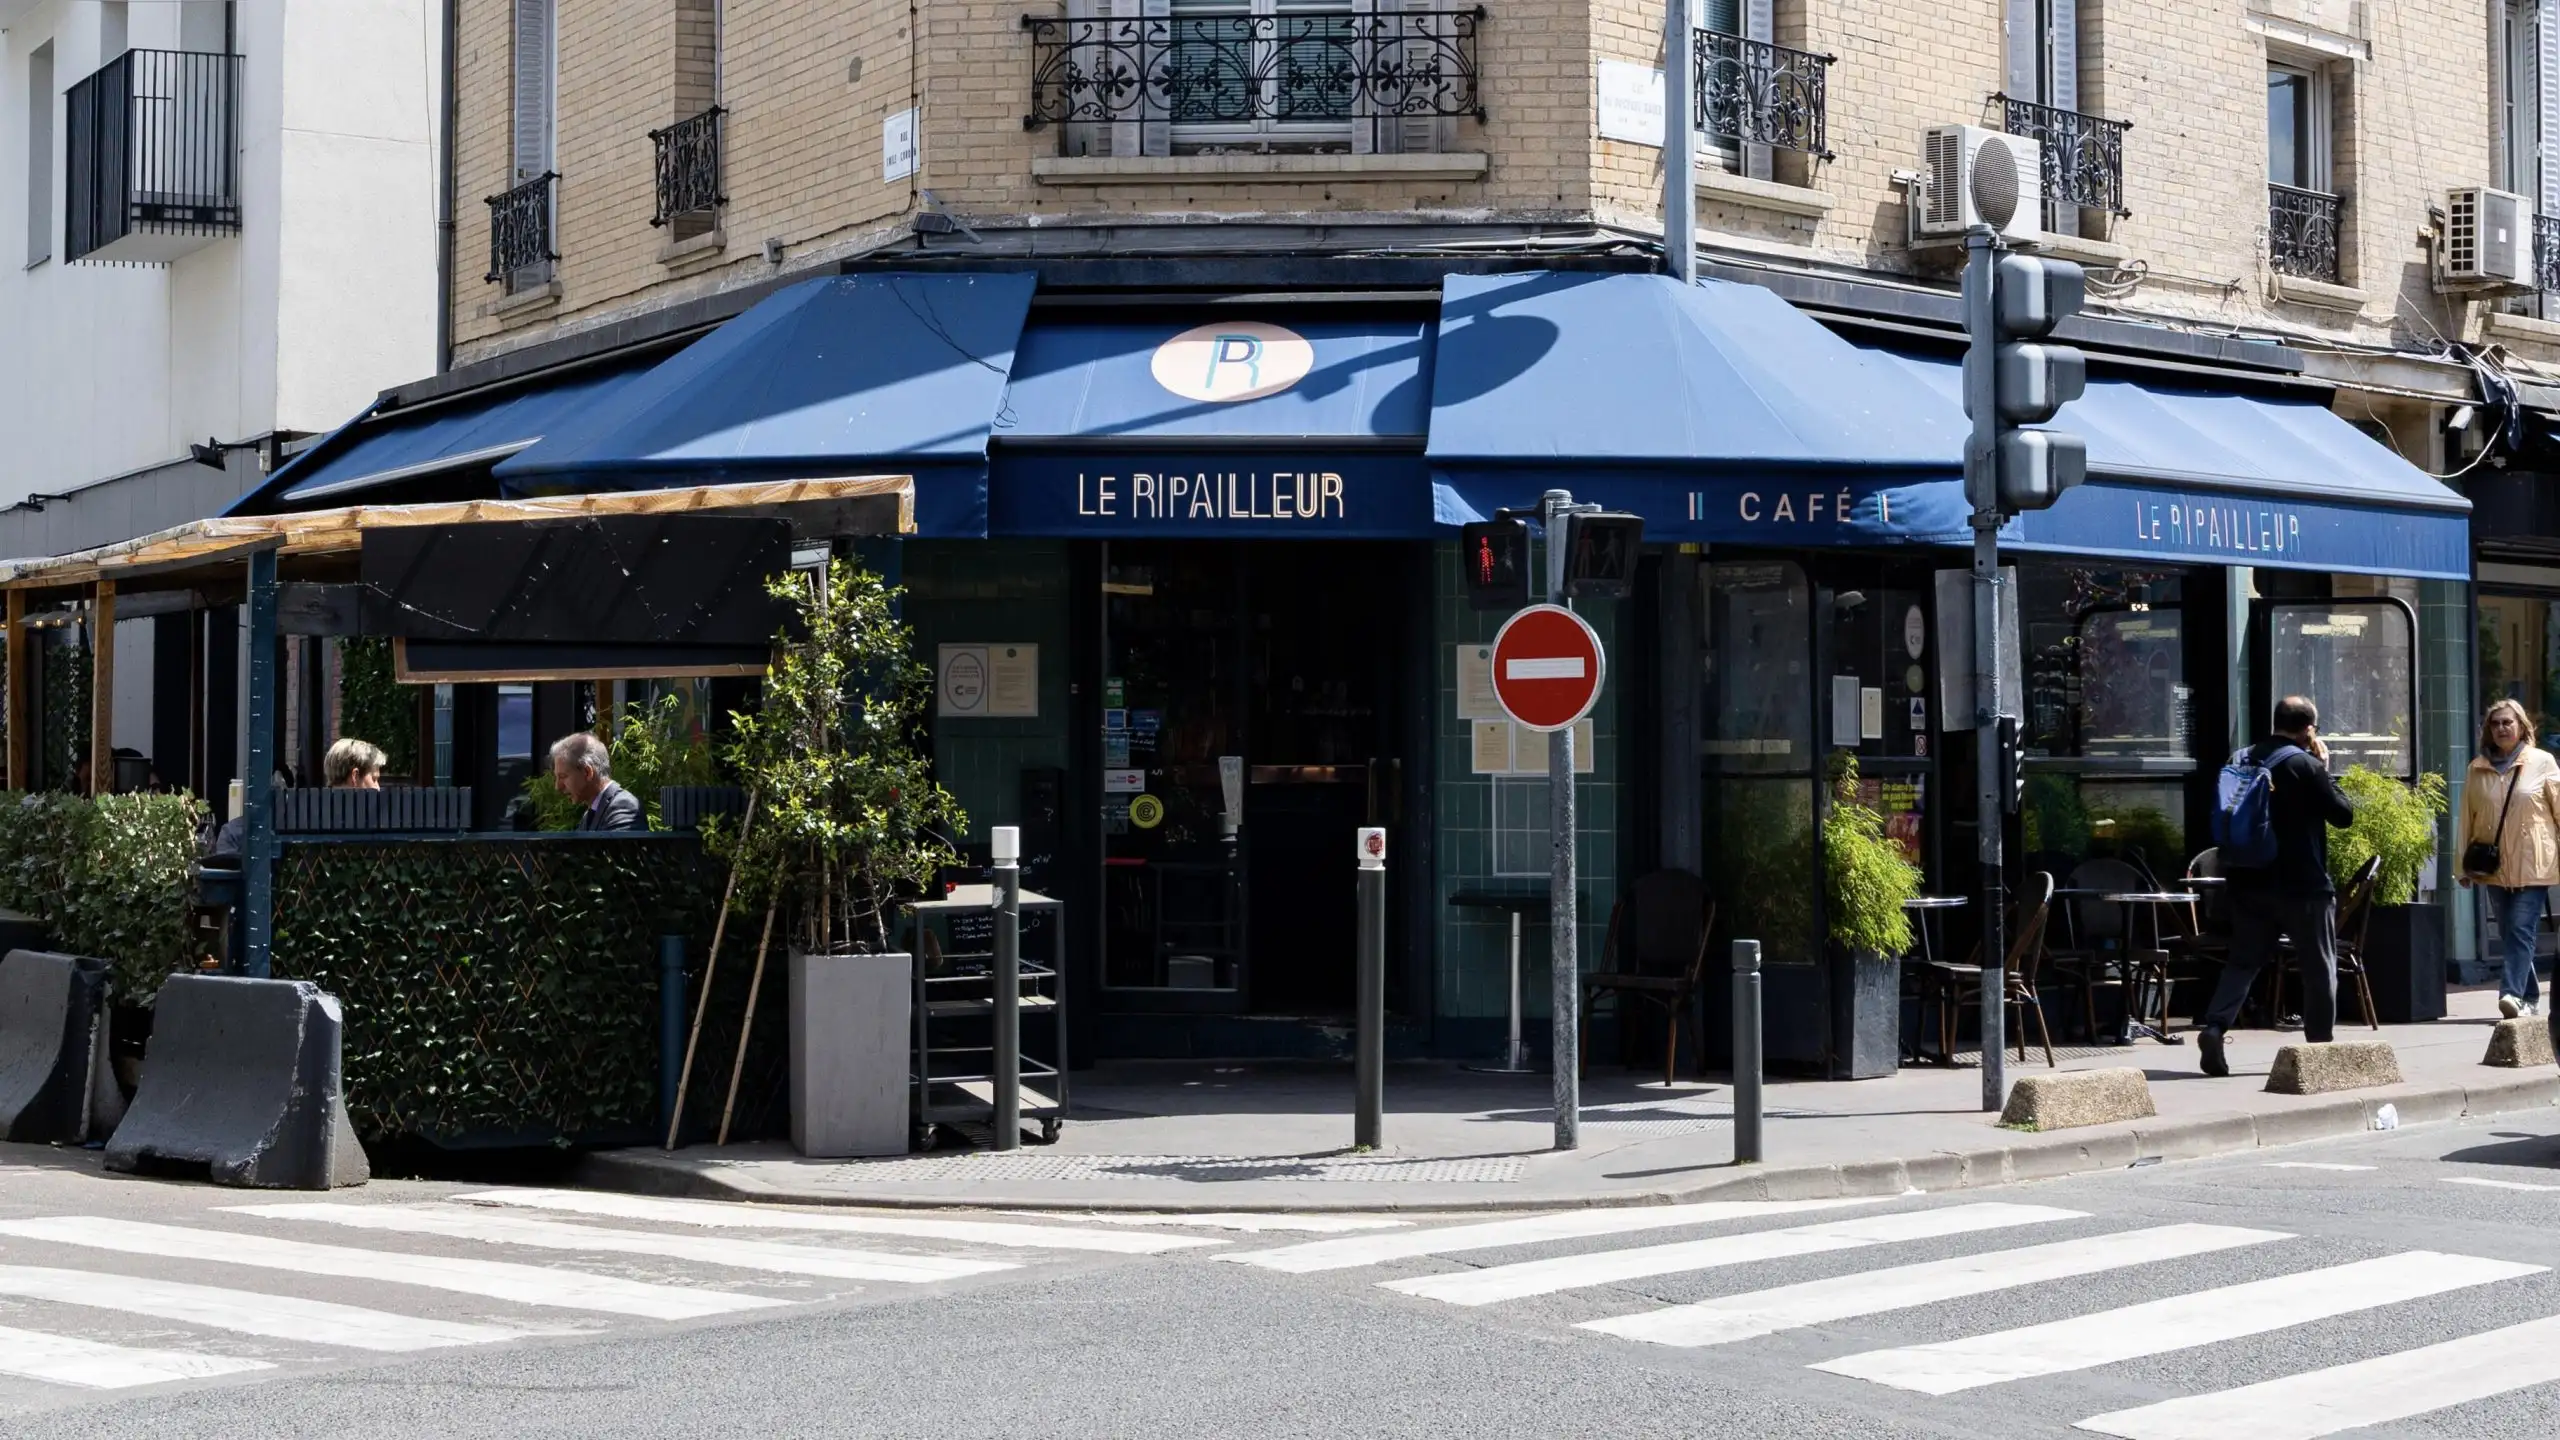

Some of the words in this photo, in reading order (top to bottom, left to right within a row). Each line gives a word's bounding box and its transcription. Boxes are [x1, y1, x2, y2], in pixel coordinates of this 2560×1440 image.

[1205, 333, 1264, 389] R
[1079, 473, 1117, 516] LE
[1133, 473, 1344, 518] RIPAILLEUR
[1739, 486, 1851, 522] CAFÉ
[2137, 501, 2162, 540] LE
[2170, 504, 2301, 553] RIPAILLEUR
